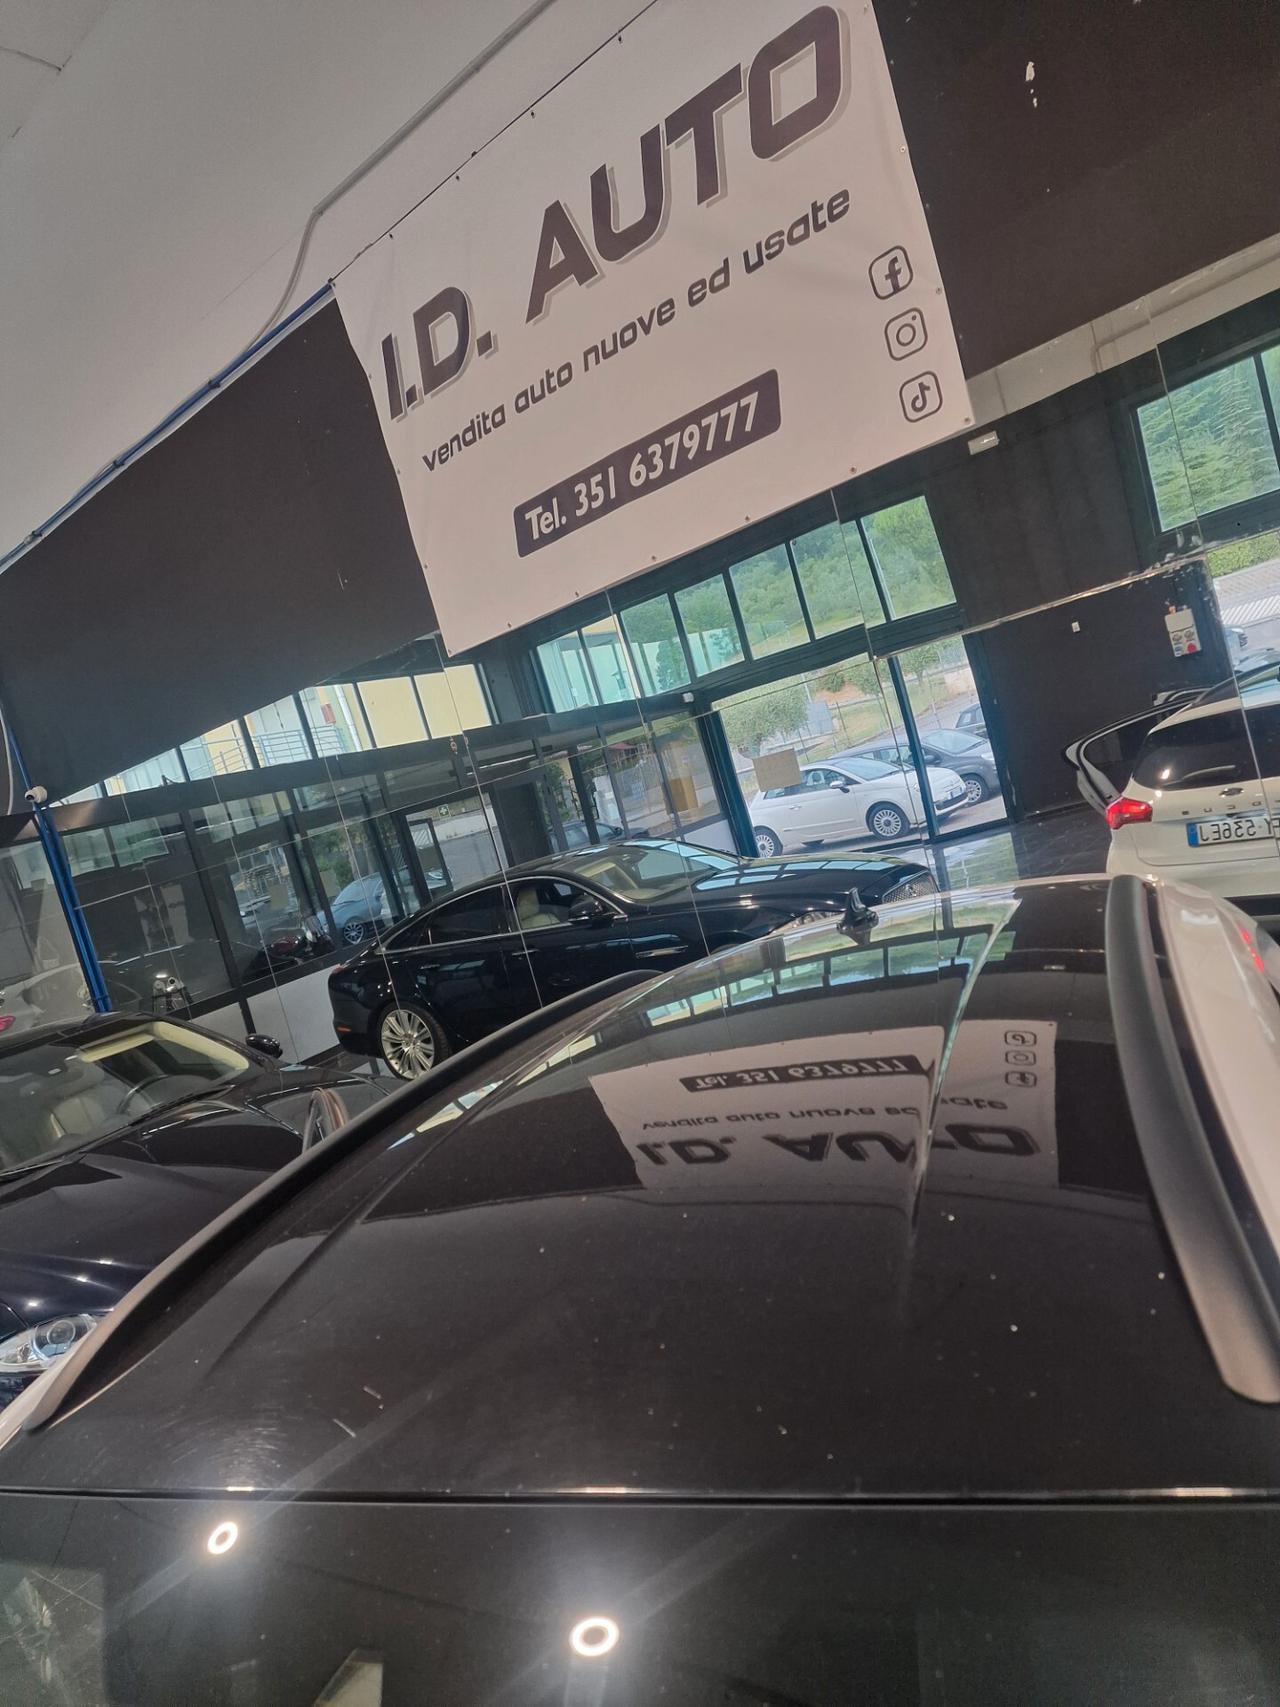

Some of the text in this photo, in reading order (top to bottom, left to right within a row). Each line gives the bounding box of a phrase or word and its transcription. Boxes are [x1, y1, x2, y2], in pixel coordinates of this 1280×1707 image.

[380, 5, 851, 421] I.D. AUTO
[422, 188, 850, 472] vendita auto nuove ed usate
[524, 391, 759, 541] Tel. 351 6379777
